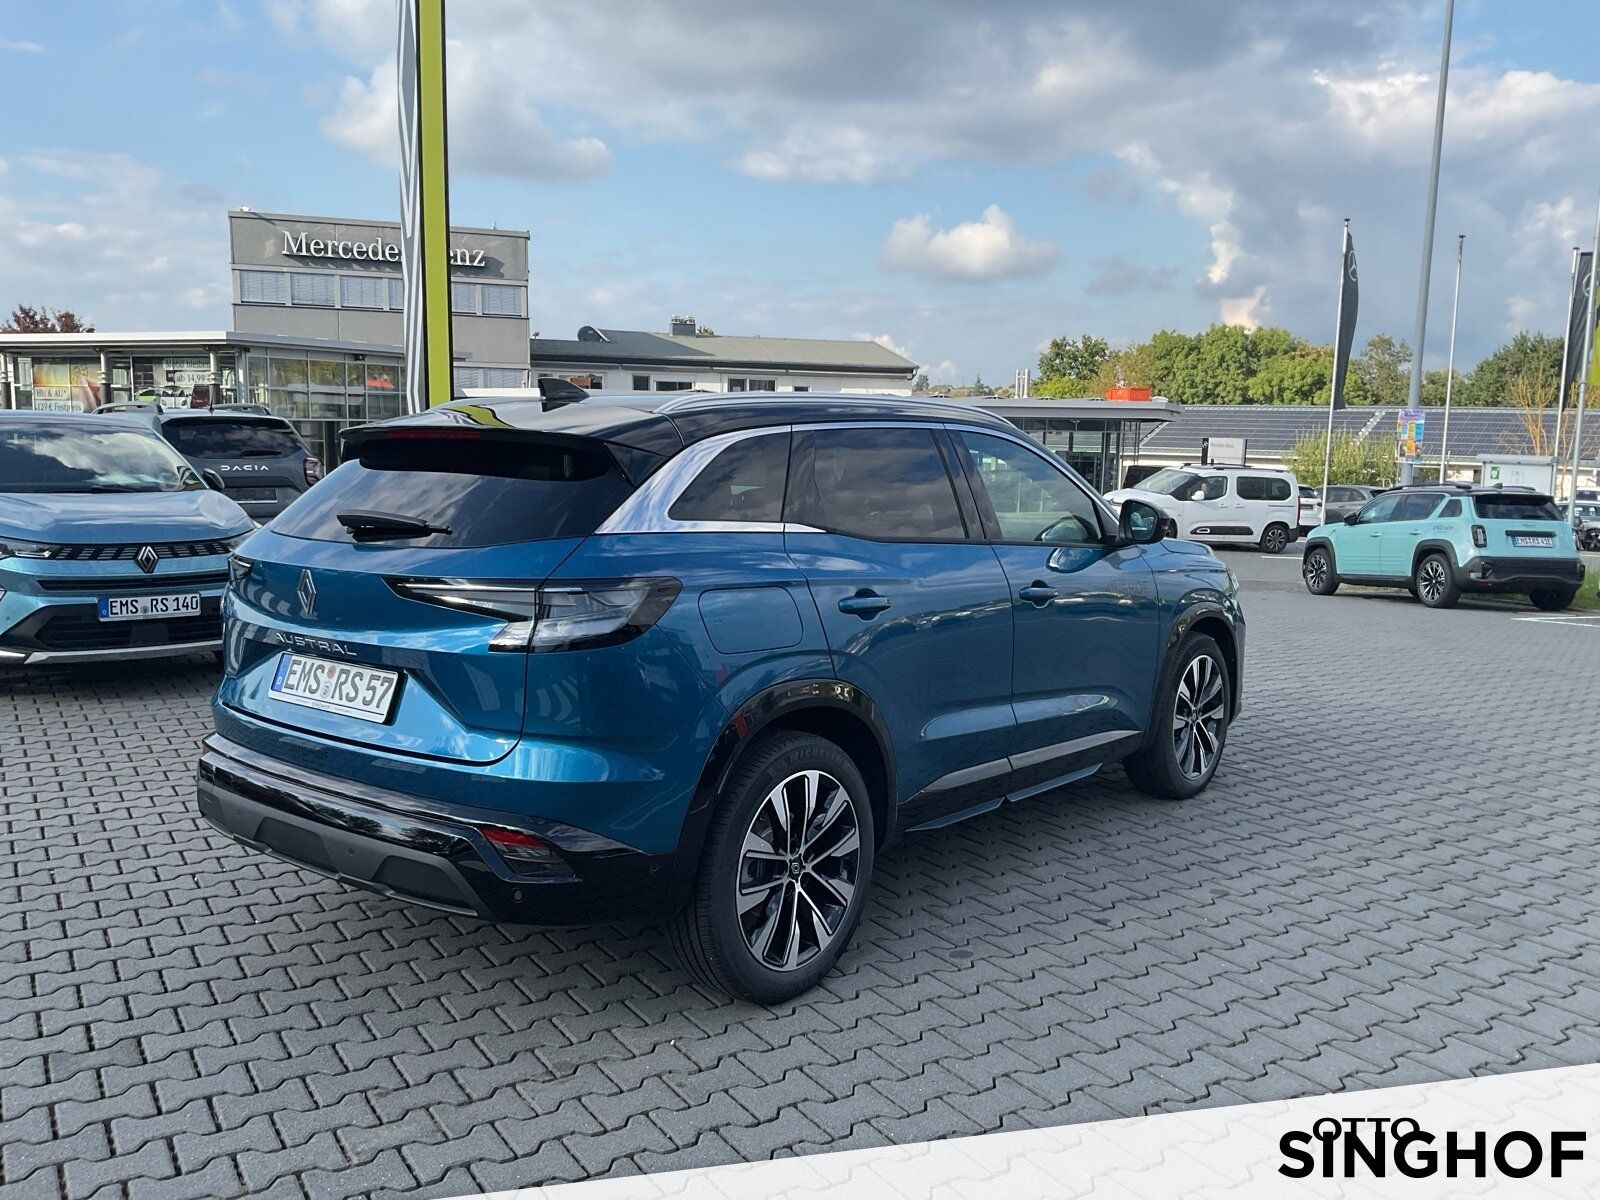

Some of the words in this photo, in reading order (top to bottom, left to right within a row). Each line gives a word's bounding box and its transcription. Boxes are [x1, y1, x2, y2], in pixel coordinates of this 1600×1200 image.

[48, 390, 53, 398] &
[54, 402, 82, 412] Festpeis
[109, 599, 139, 615] EMS
[150, 597, 169, 613] RS
[172, 595, 199, 612] 140
[275, 632, 358, 656] AUSTRAL
[283, 659, 326, 695] EMS
[330, 668, 364, 703] RS
[362, 673, 395, 709] 57
